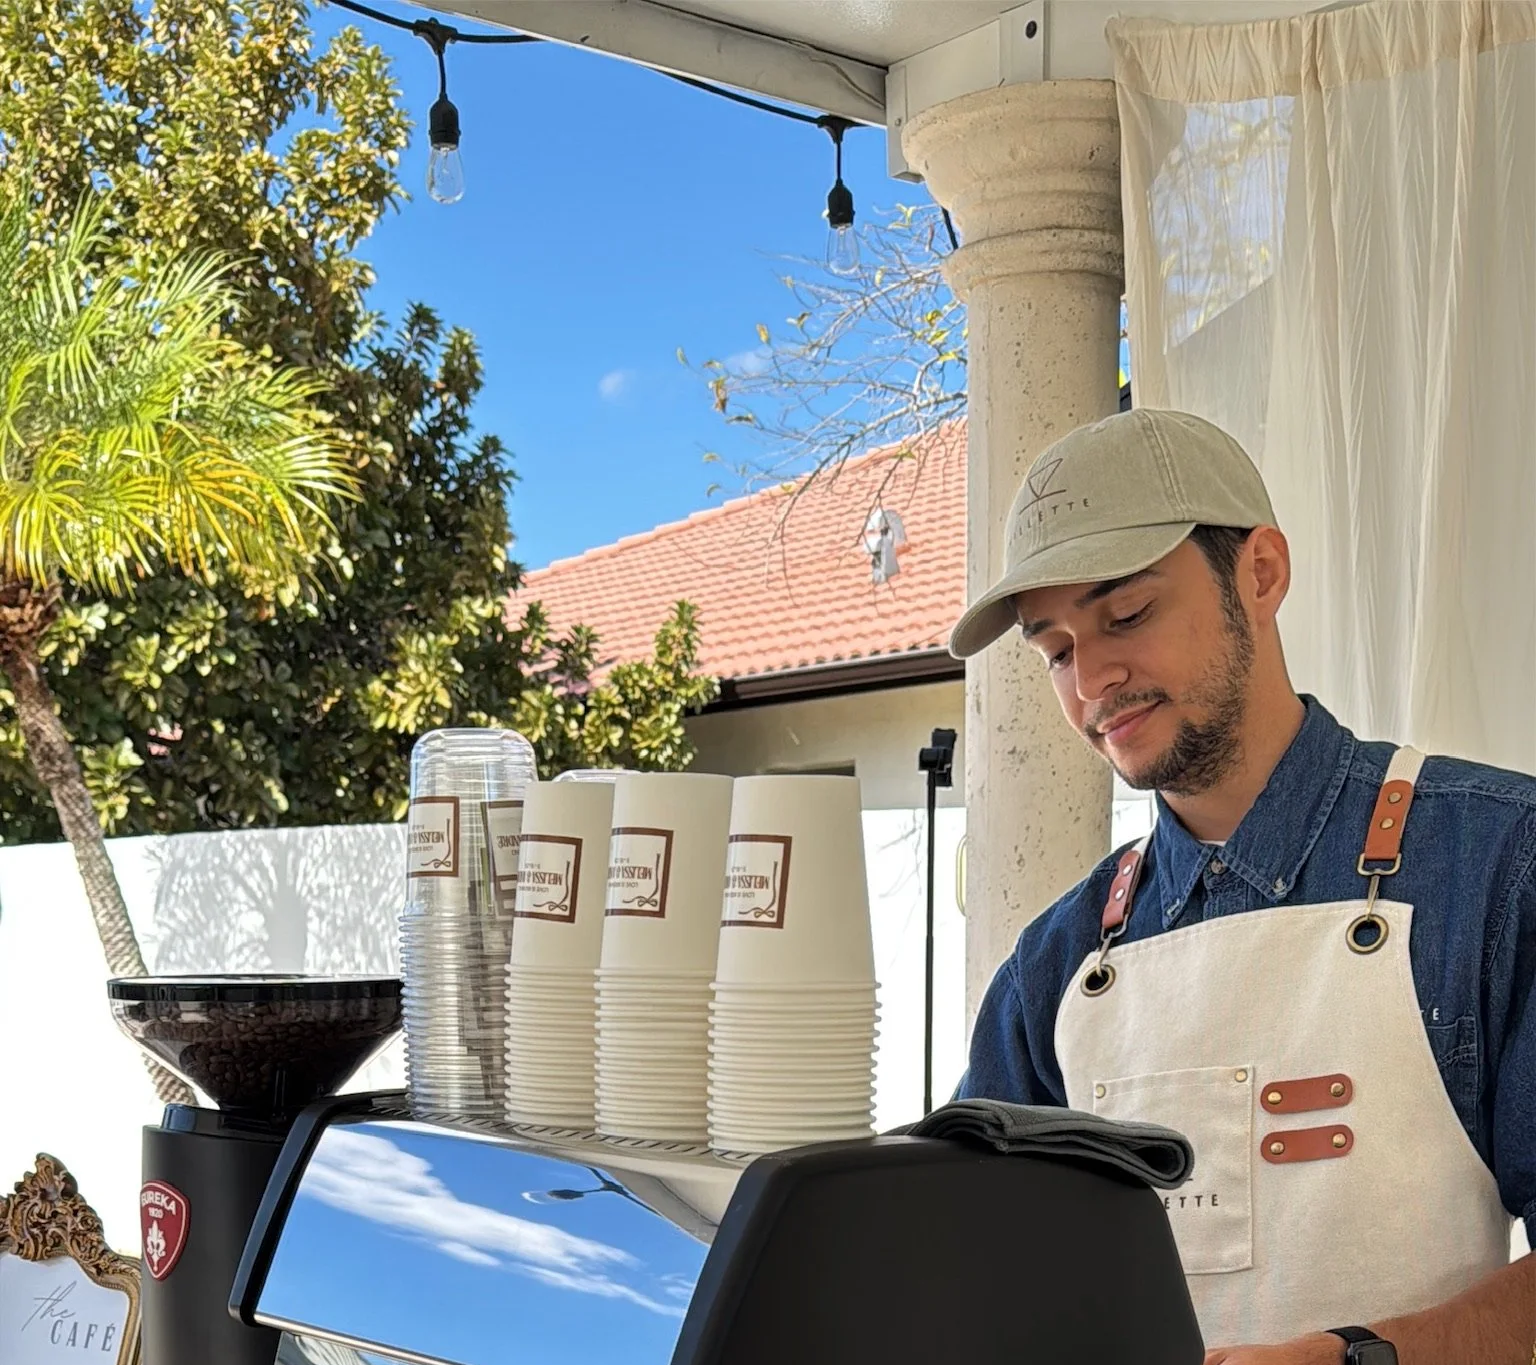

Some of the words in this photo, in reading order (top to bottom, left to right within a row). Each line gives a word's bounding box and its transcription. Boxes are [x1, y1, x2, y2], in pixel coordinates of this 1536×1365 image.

[141, 1190, 176, 1216] EUREKA
[21, 1280, 77, 1332] the
[51, 1318, 116, 1352] CAFÉ
